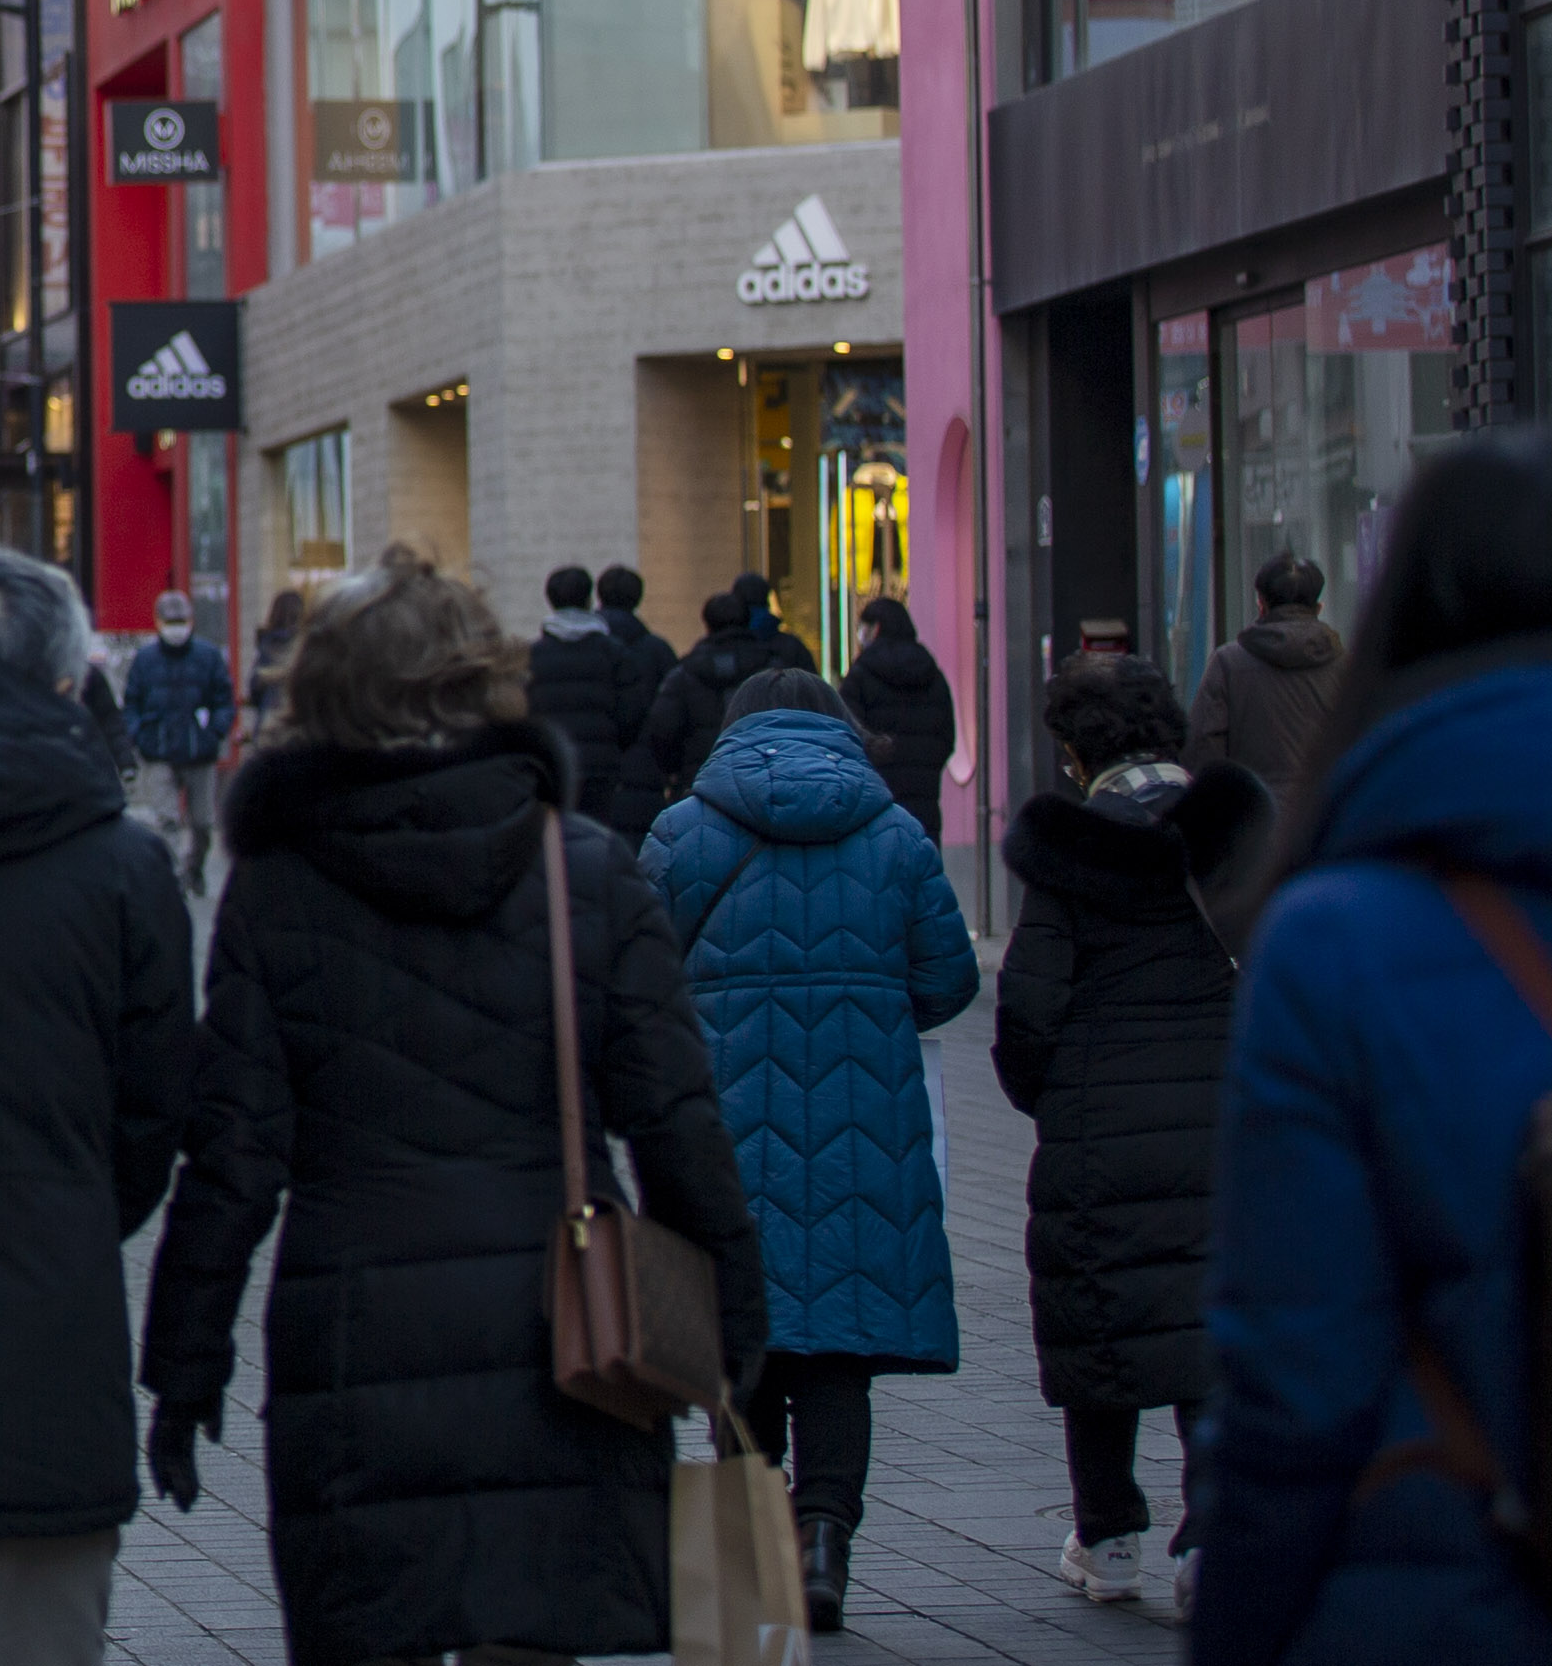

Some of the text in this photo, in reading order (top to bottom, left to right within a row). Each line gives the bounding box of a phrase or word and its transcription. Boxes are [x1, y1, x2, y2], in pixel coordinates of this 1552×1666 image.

[120, 150, 211, 175] MISSHA
[737, 260, 870, 305] adidas
[126, 370, 228, 400] adidas
[1108, 1551, 1133, 1561] FILA
